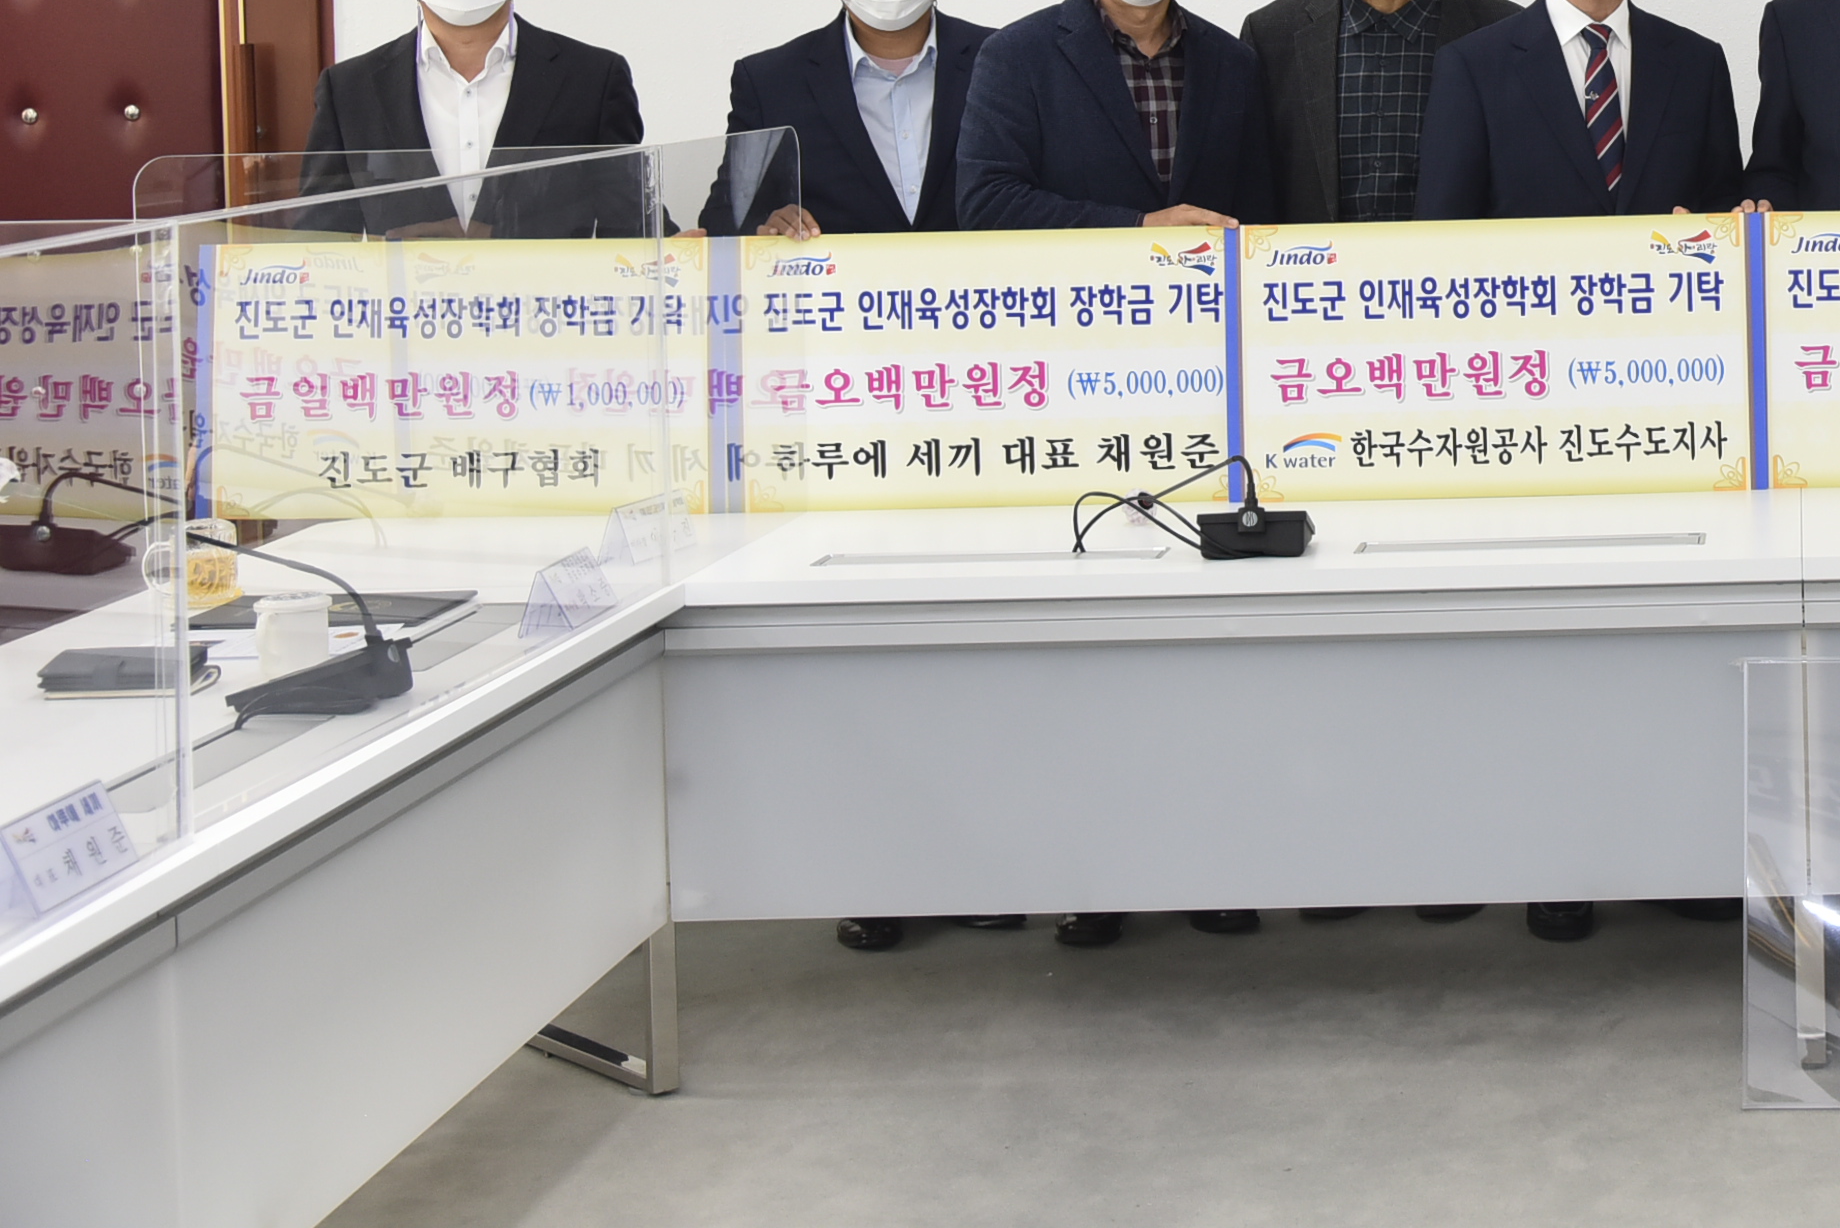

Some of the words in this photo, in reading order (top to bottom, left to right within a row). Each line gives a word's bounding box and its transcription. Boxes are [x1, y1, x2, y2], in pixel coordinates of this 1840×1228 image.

[240, 269, 298, 285] Jindo
[767, 260, 825, 277] Jindo
[1266, 249, 1325, 267] Jindo
[235, 298, 317, 340] 진도군
[330, 295, 520, 340] 인재육성장학회
[534, 294, 617, 338] 장학금
[630, 294, 687, 336] 기탁
[763, 291, 845, 332] 진도군
[858, 285, 1057, 330] 인재육성장학회
[1069, 282, 1155, 327] 장학금
[1168, 282, 1225, 324] 기탁
[1263, 280, 1347, 322] 진도군
[1359, 273, 1558, 321] 인재육성장학회
[1570, 271, 1656, 317] 장학금
[1669, 270, 1724, 313] 기탁
[239, 370, 519, 421] 금일백만원정
[773, 360, 1049, 414] 금오백만원정
[1067, 365, 1225, 401] (₩5,000,000)
[1270, 349, 1550, 404] 금오백만원정
[1567, 354, 1725, 390] (₩5,000,000)
[319, 451, 433, 489] 진도군
[450, 448, 600, 490] 배구협회
[772, 439, 886, 480] 하루에
[906, 437, 982, 480] 세끼
[1002, 435, 1080, 477] 대표
[1096, 431, 1221, 473] 채원준
[1351, 427, 1548, 469] 한국수자원공사
[1559, 420, 1728, 464] 진도수도지사
